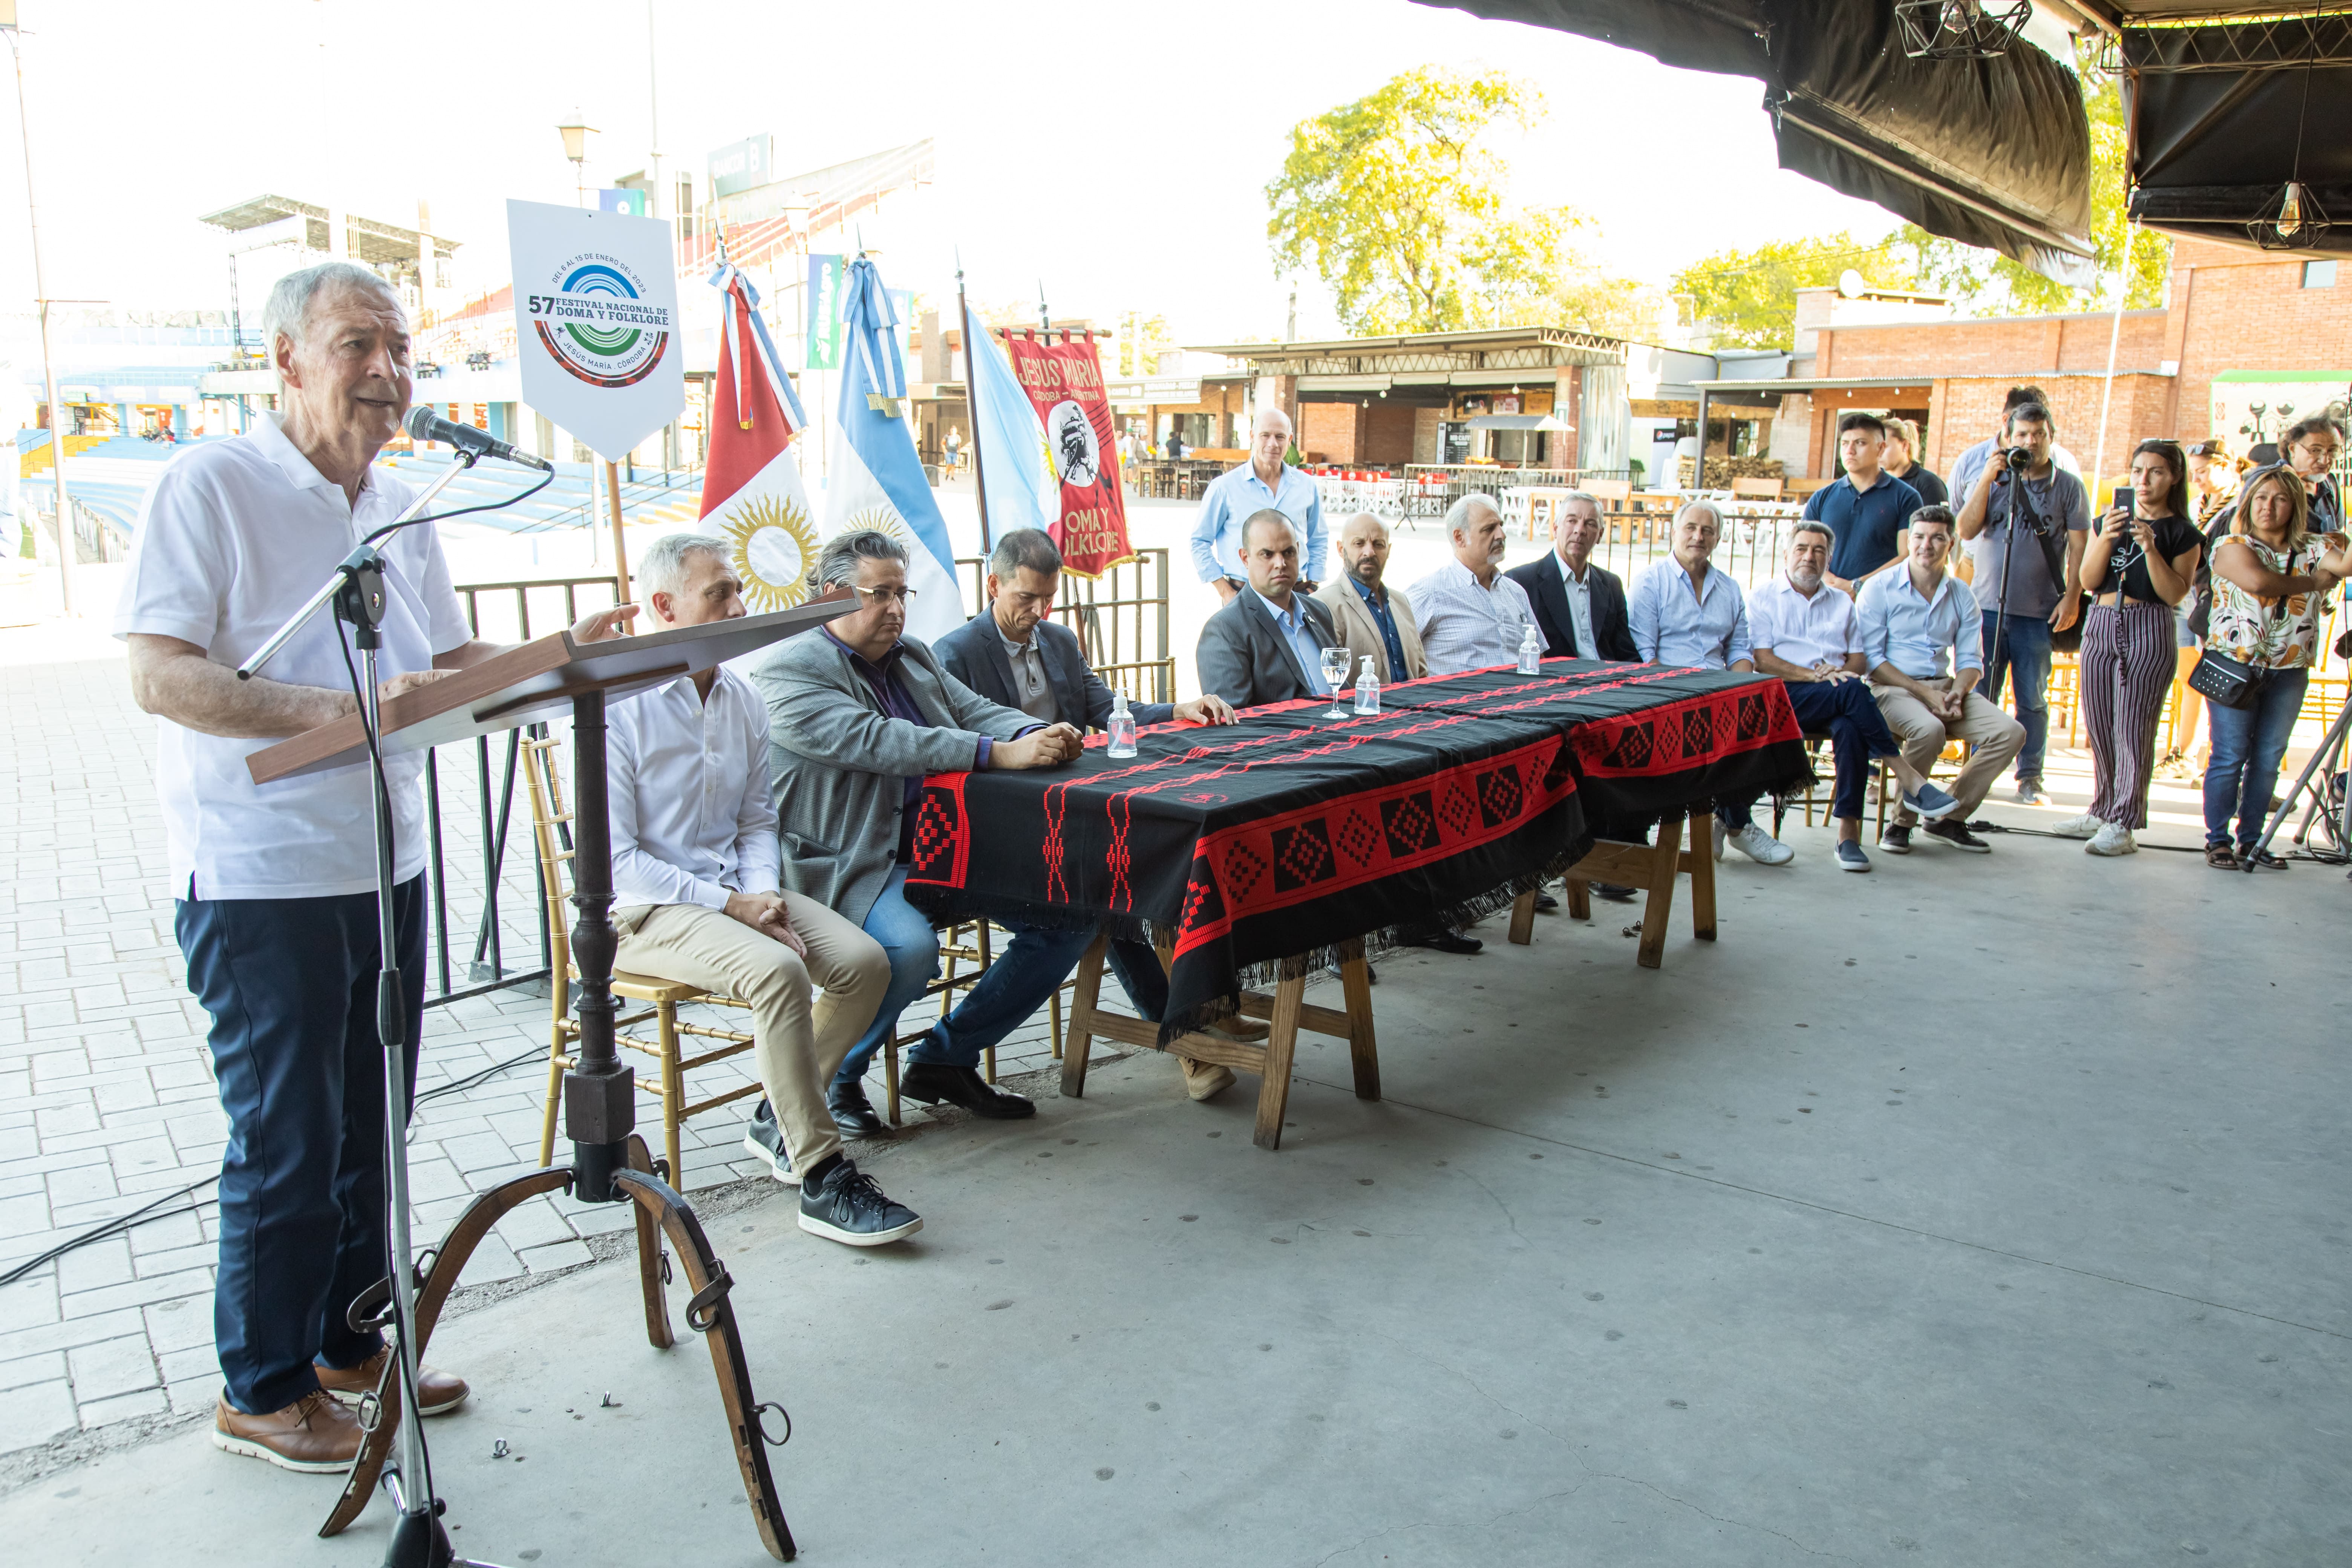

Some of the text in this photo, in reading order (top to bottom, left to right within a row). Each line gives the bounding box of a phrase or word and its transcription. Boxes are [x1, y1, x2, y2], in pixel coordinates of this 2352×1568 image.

[552, 271, 563, 283] DEL
[567, 259, 575, 268] AL
[596, 253, 619, 265] ENERO
[620, 263, 631, 275] DEL
[632, 275, 646, 292] 2023
[529, 296, 555, 314] 57
[555, 298, 603, 309] FESTIVAL
[606, 302, 654, 314] NACIONAL
[556, 306, 669, 325] DOMA Y FOLKLORE
[564, 342, 586, 361] JESÚS
[588, 359, 612, 369] MARÍA
[617, 346, 646, 369] CÓRDOBA
[1018, 357, 1102, 387] JESUS MARIA
[1066, 507, 1109, 533] OMA Y
